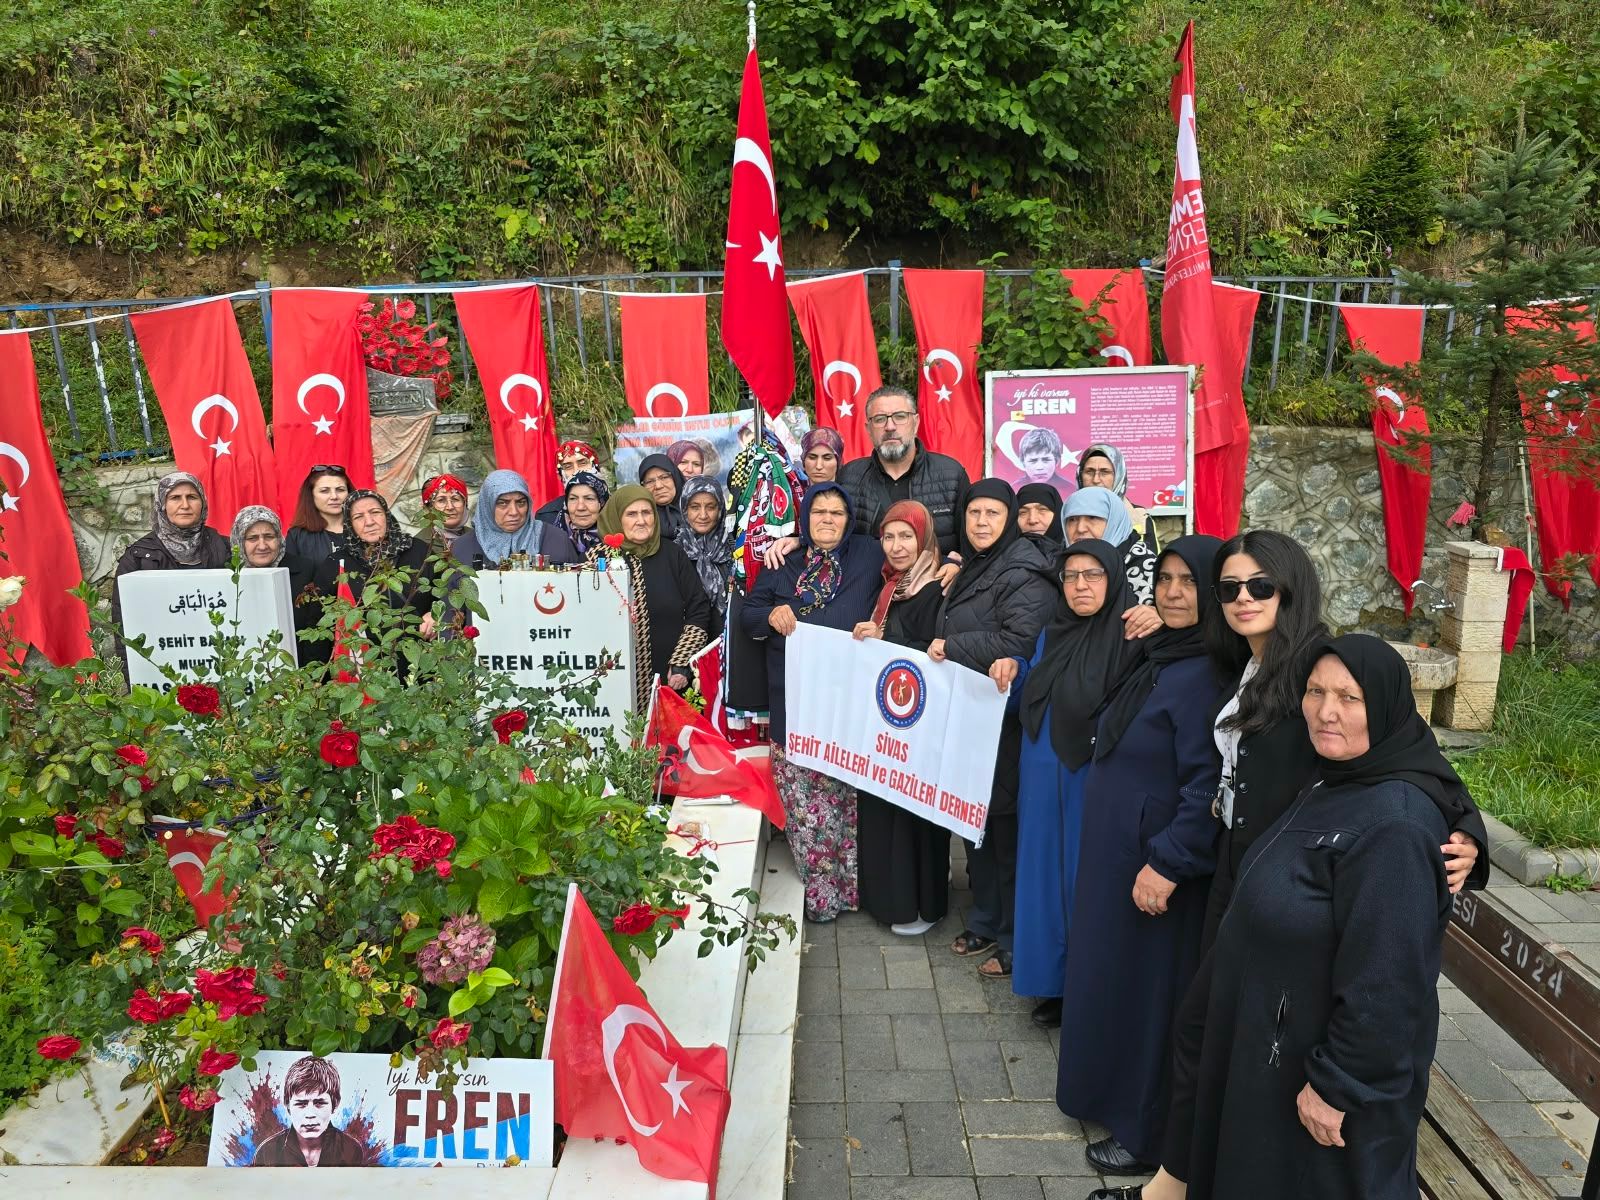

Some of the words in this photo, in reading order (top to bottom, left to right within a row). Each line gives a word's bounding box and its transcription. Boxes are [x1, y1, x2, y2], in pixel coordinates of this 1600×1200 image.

[1028, 382, 1045, 398] ki
[1021, 398, 1076, 416] EREN
[158, 634, 195, 650] ŞEHİT
[529, 625, 572, 642] ŞEHİT
[478, 654, 533, 671] EREN
[876, 731, 909, 763] SİVAS
[788, 732, 822, 758] ŞEHİT
[823, 741, 871, 777] AİLELERİ
[872, 763, 886, 784] ve
[889, 773, 938, 807] GAZİLERİ
[939, 790, 987, 830] DERNEĞİ
[1500, 929, 1564, 999] 2024
[393, 1088, 531, 1161] EREN
